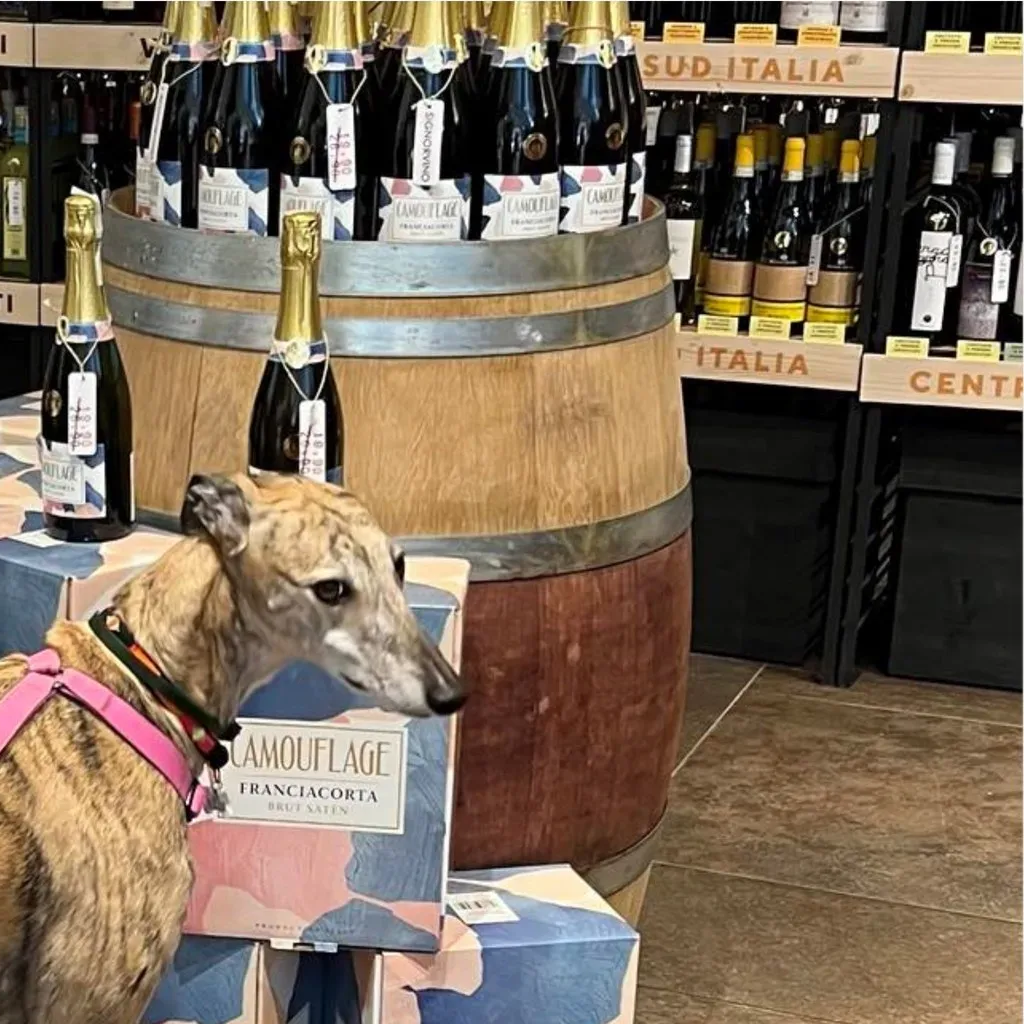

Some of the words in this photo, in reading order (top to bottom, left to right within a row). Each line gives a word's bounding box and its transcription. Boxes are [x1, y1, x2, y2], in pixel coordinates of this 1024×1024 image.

[642, 54, 712, 78] SUD
[727, 56, 845, 83] ITALIA
[420, 110, 435, 184] SIGNORVINO
[697, 346, 809, 376] ITALIA
[230, 734, 391, 777] CAMOUFLAGE
[239, 782, 379, 803] FRANCIACORTA
[267, 801, 301, 812] BRUT
